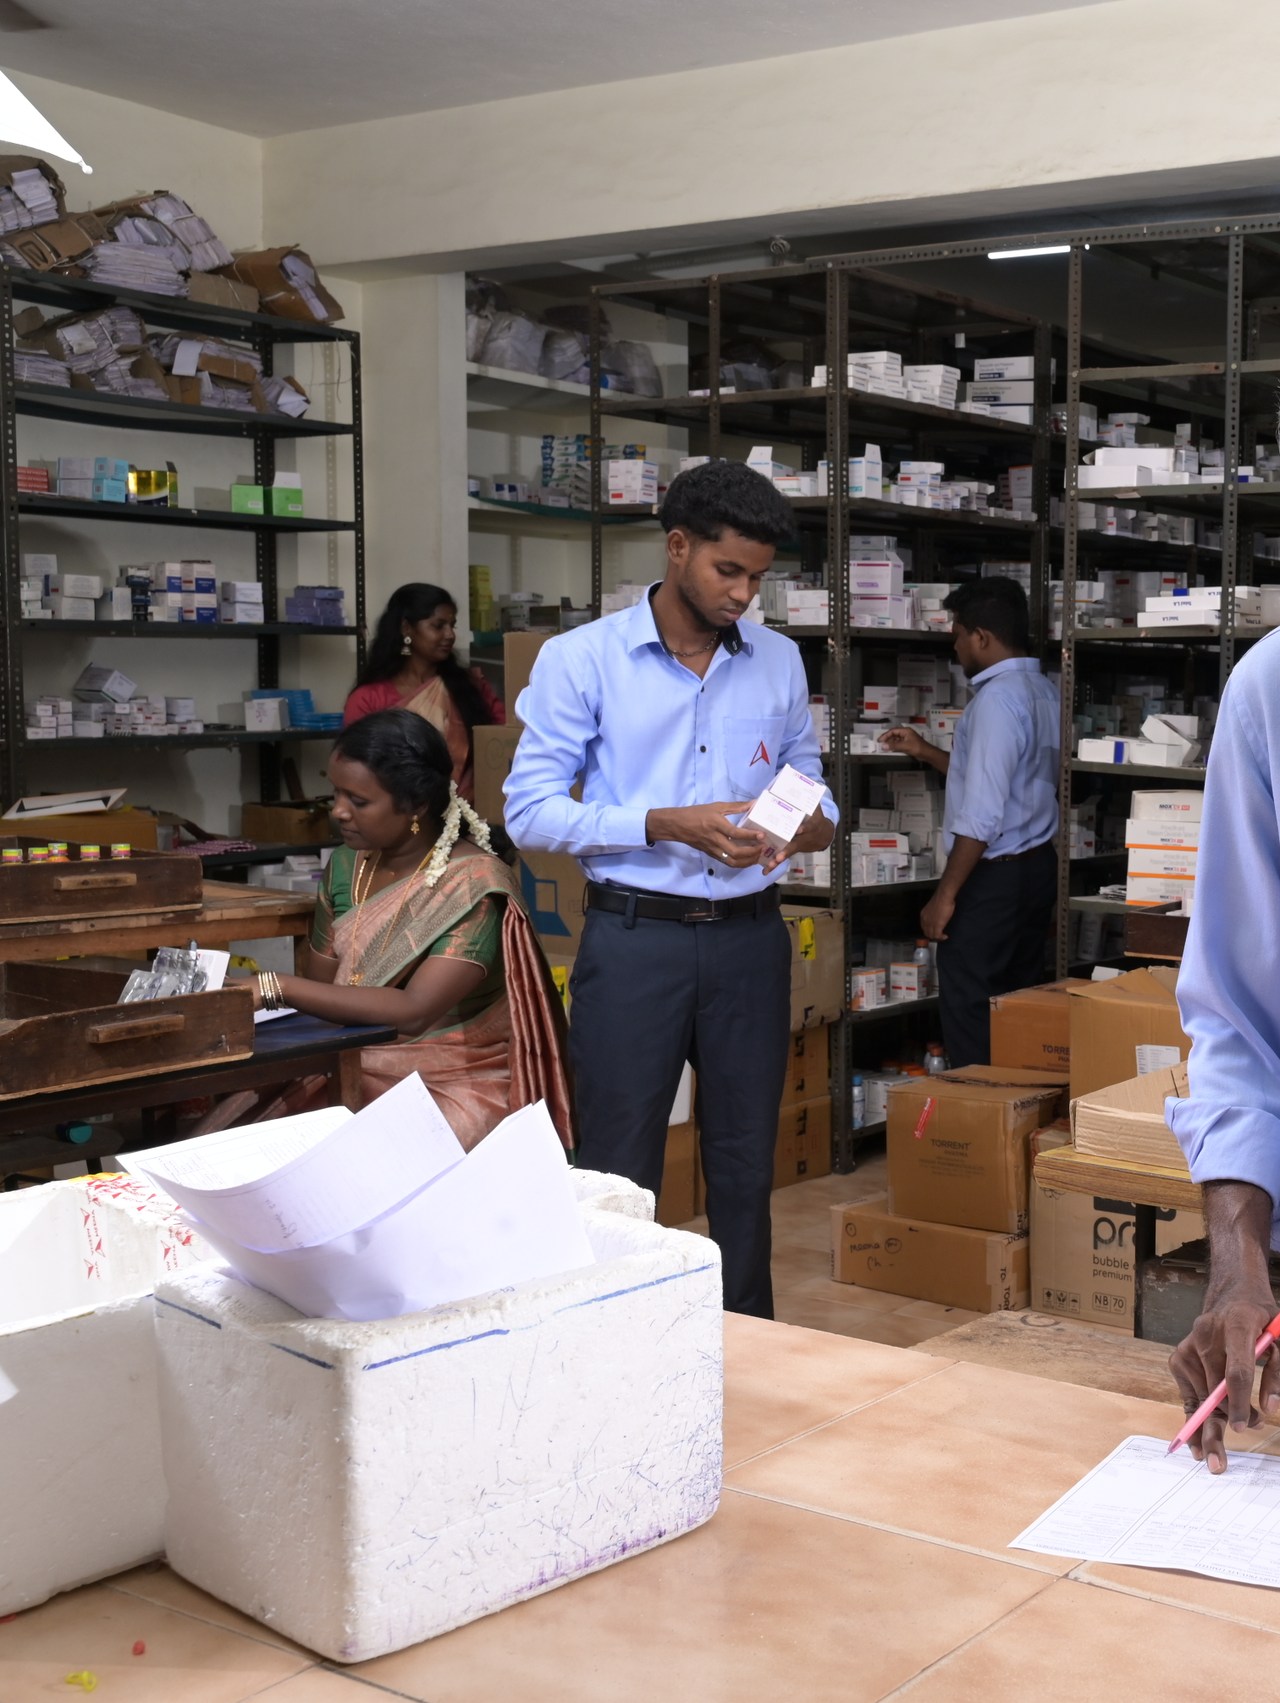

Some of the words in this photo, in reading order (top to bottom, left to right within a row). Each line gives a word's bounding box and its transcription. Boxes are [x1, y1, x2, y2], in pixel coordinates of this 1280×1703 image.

[1042, 1044, 1070, 1056] TORRE
[930, 1138, 971, 1151] TORRENT
[1093, 1216, 1136, 1251] pr
[1092, 1254, 1130, 1270] bubble
[1092, 1269, 1133, 1282] premium
[1094, 1294, 1109, 1306] NB
[1112, 1297, 1124, 1309] 70
